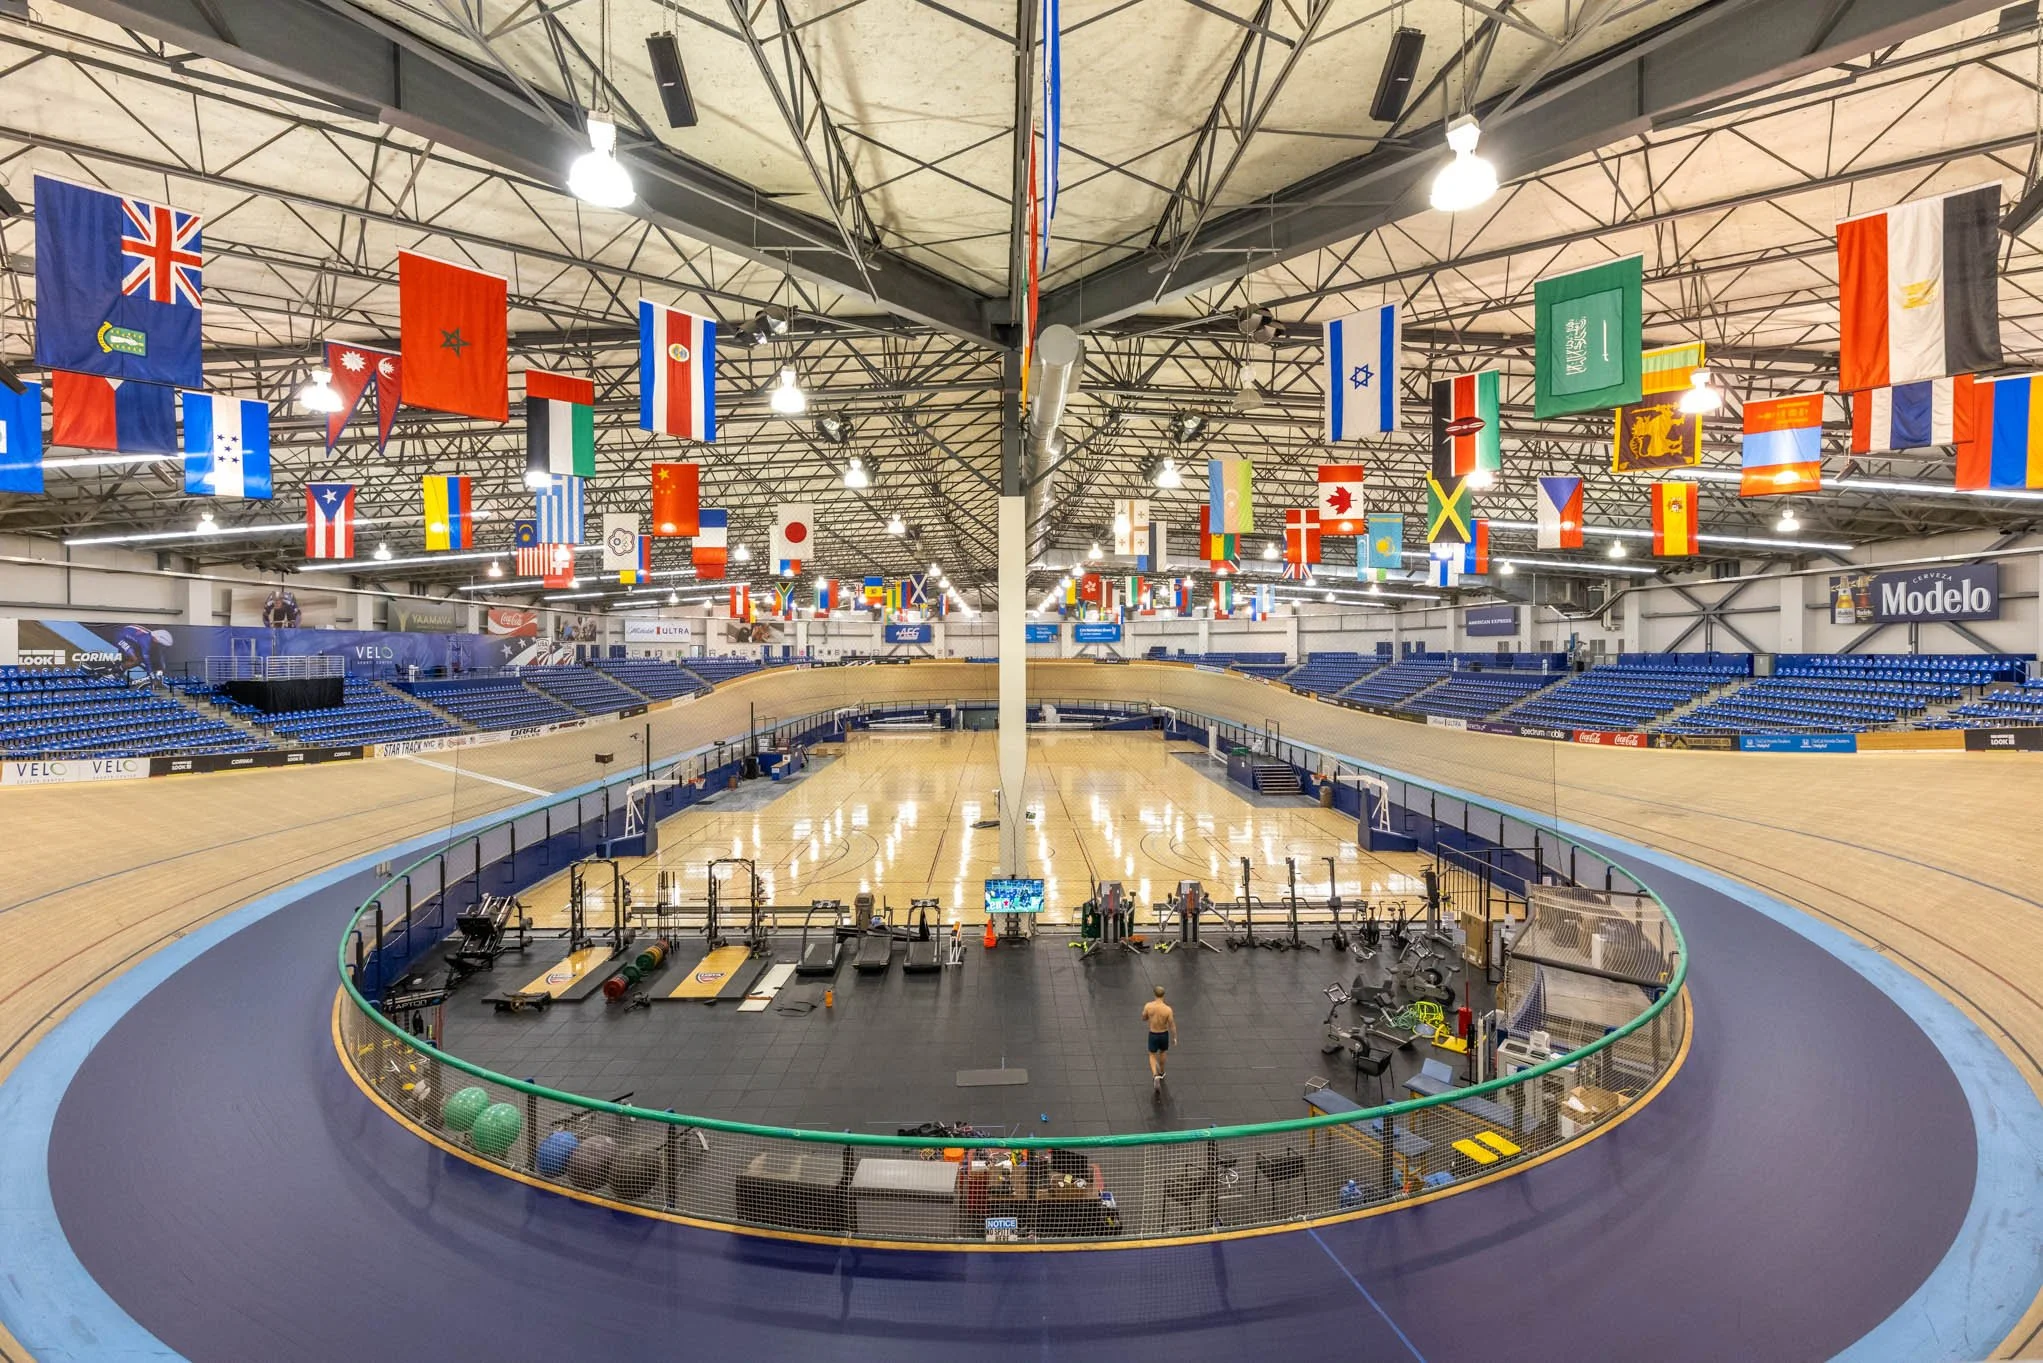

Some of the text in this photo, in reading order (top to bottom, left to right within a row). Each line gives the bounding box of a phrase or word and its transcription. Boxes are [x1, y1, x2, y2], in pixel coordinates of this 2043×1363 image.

[1912, 572, 1952, 584] CERVEZA
[1881, 578, 1992, 616] Modelo
[662, 627, 690, 635] ULTRA
[72, 652, 123, 662] CORIMA
[356, 646, 393, 659] VELO
[18, 656, 54, 666] LOOK
[510, 727, 541, 736] DRAG
[1520, 726, 1546, 737] Spectrum
[1579, 732, 1601, 744] Coca-Cola
[1614, 732, 1638, 746] Coca-Cola
[1991, 738, 2009, 746] LOOK
[383, 744, 400, 757] STAR
[401, 741, 422, 754] TRACK
[423, 740, 436, 748] NYC
[17, 762, 67, 777] VELO
[93, 759, 138, 774] VELO
[987, 1220, 1016, 1228] NOTICE
